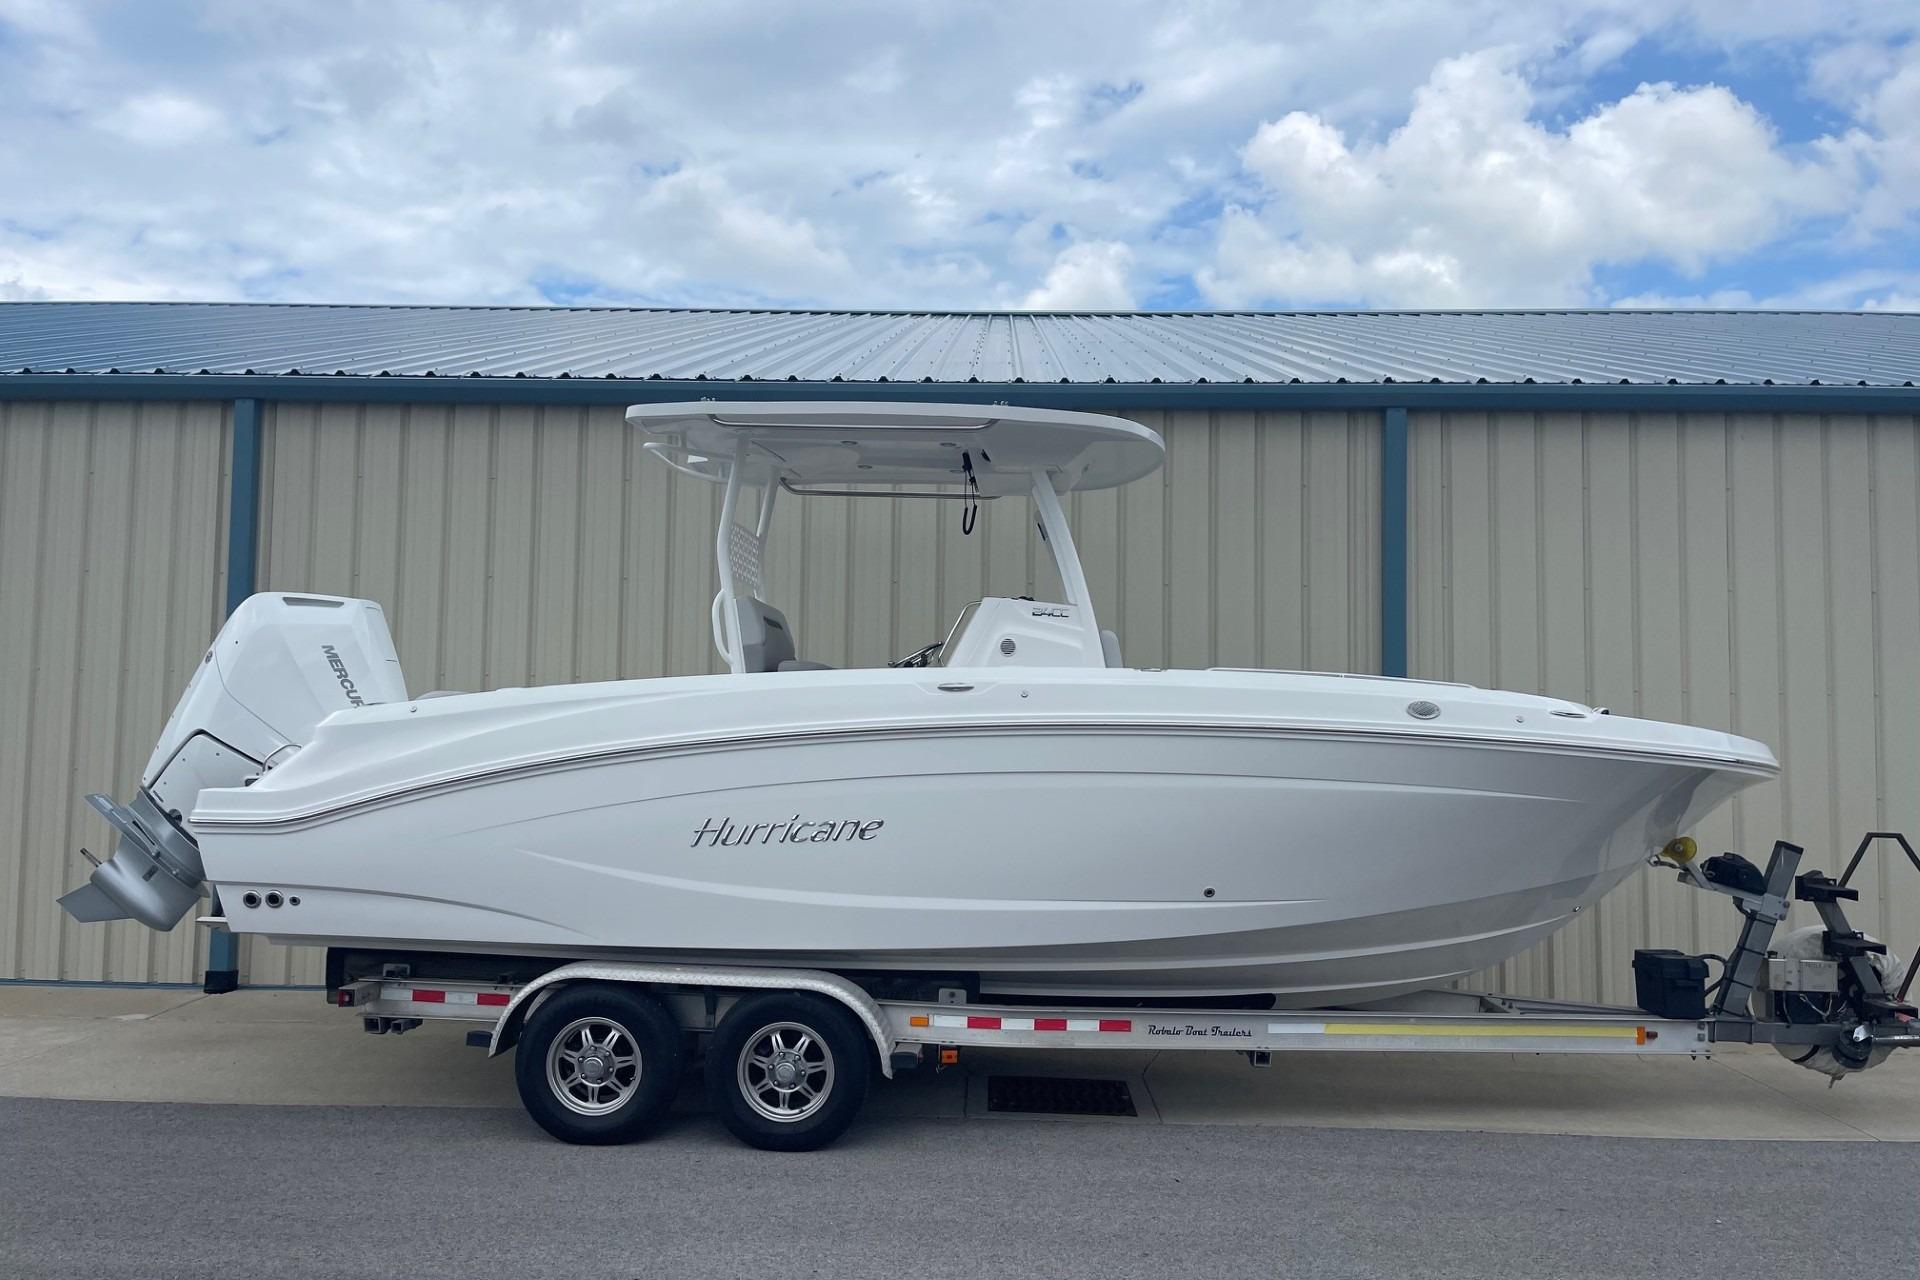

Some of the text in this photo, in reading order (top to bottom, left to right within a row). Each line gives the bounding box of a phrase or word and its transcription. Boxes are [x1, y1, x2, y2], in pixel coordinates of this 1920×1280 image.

[321, 645, 365, 709] MERCUR
[690, 814, 884, 848] Hurricane
[1148, 1024, 1253, 1037] Robalo Boat Trailers
